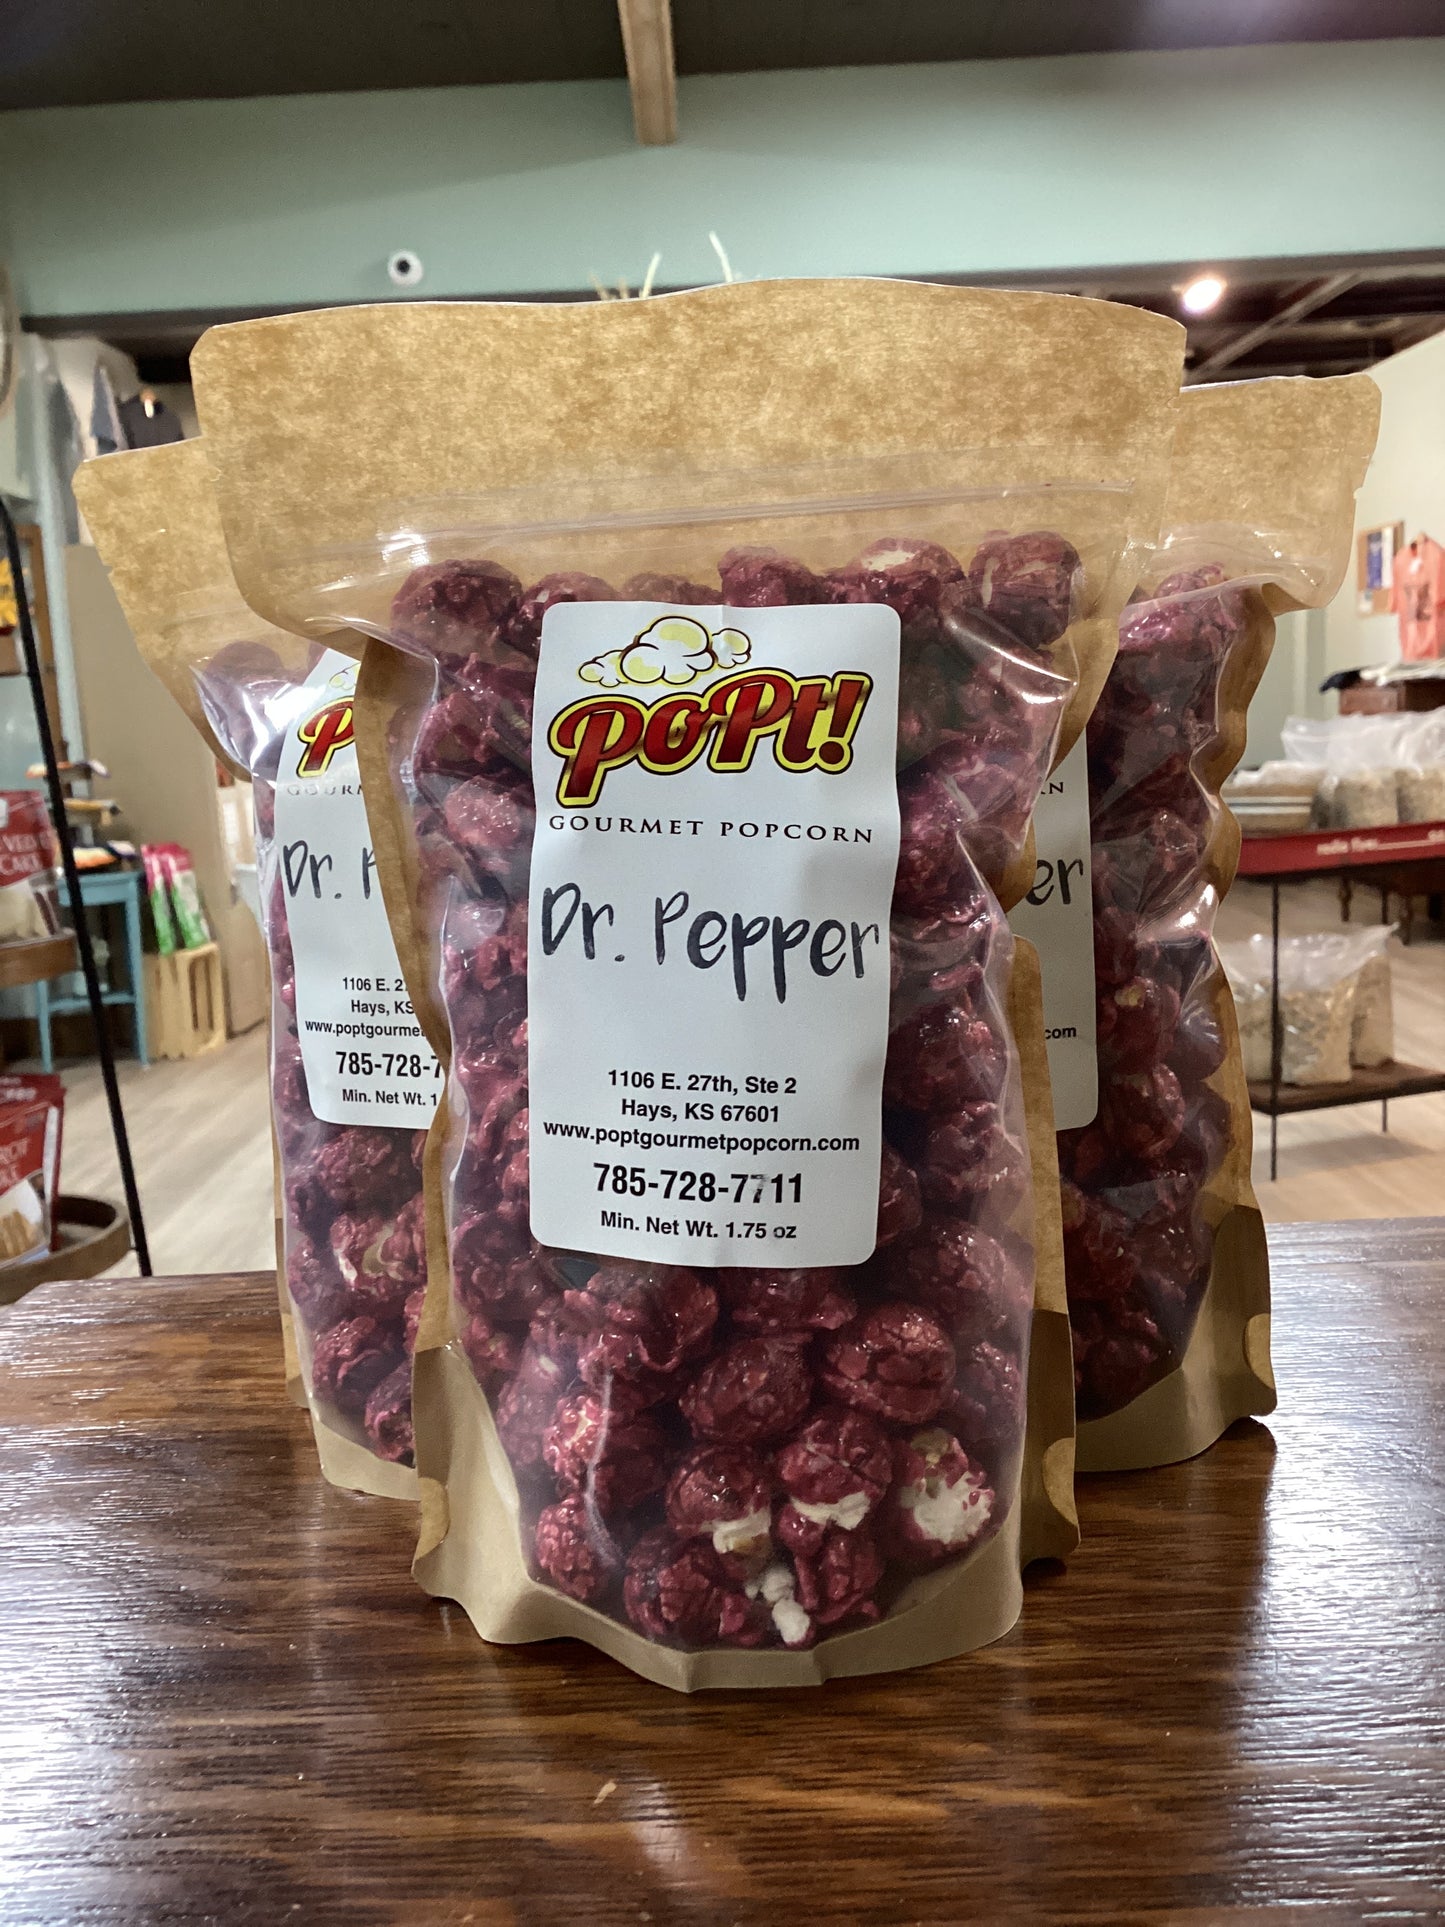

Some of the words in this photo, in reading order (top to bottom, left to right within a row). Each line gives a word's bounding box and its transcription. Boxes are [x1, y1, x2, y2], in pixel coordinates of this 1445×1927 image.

[549, 815, 704, 836] GOURMET
[721, 821, 873, 844] POPCORN
[283, 840, 342, 899] Dr.
[1026, 859, 1083, 906] er
[541, 882, 626, 962] Dr.
[655, 891, 880, 1004] Pepper
[342, 977, 372, 991] 1106
[376, 978, 390, 992] E.
[351, 1000, 390, 1016] Hays,
[394, 1001, 415, 1014] KS
[1045, 1027, 1077, 1039] com
[336, 1051, 442, 1078] 785-728-7
[608, 1069, 655, 1089] 1106
[661, 1072, 681, 1090] E.
[687, 1074, 738, 1096] 27th,
[745, 1076, 779, 1094] Ste
[784, 1077, 797, 1094] 2
[342, 1089, 371, 1103] Min.
[375, 1090, 399, 1104] Net
[403, 1091, 426, 1106] Wt.
[431, 1094, 437, 1106] 1
[621, 1098, 677, 1122] Hays,
[685, 1102, 714, 1120] KS
[720, 1104, 779, 1122] 67601
[543, 1121, 860, 1155] www.poptgourmetpopcorn.com
[593, 1162, 802, 1204] 785-728-7711
[601, 1210, 640, 1231] Min.
[646, 1216, 680, 1236] Net
[686, 1220, 718, 1238] Wt.
[725, 1222, 767, 1239] 1.75
[773, 1224, 797, 1239] oz
